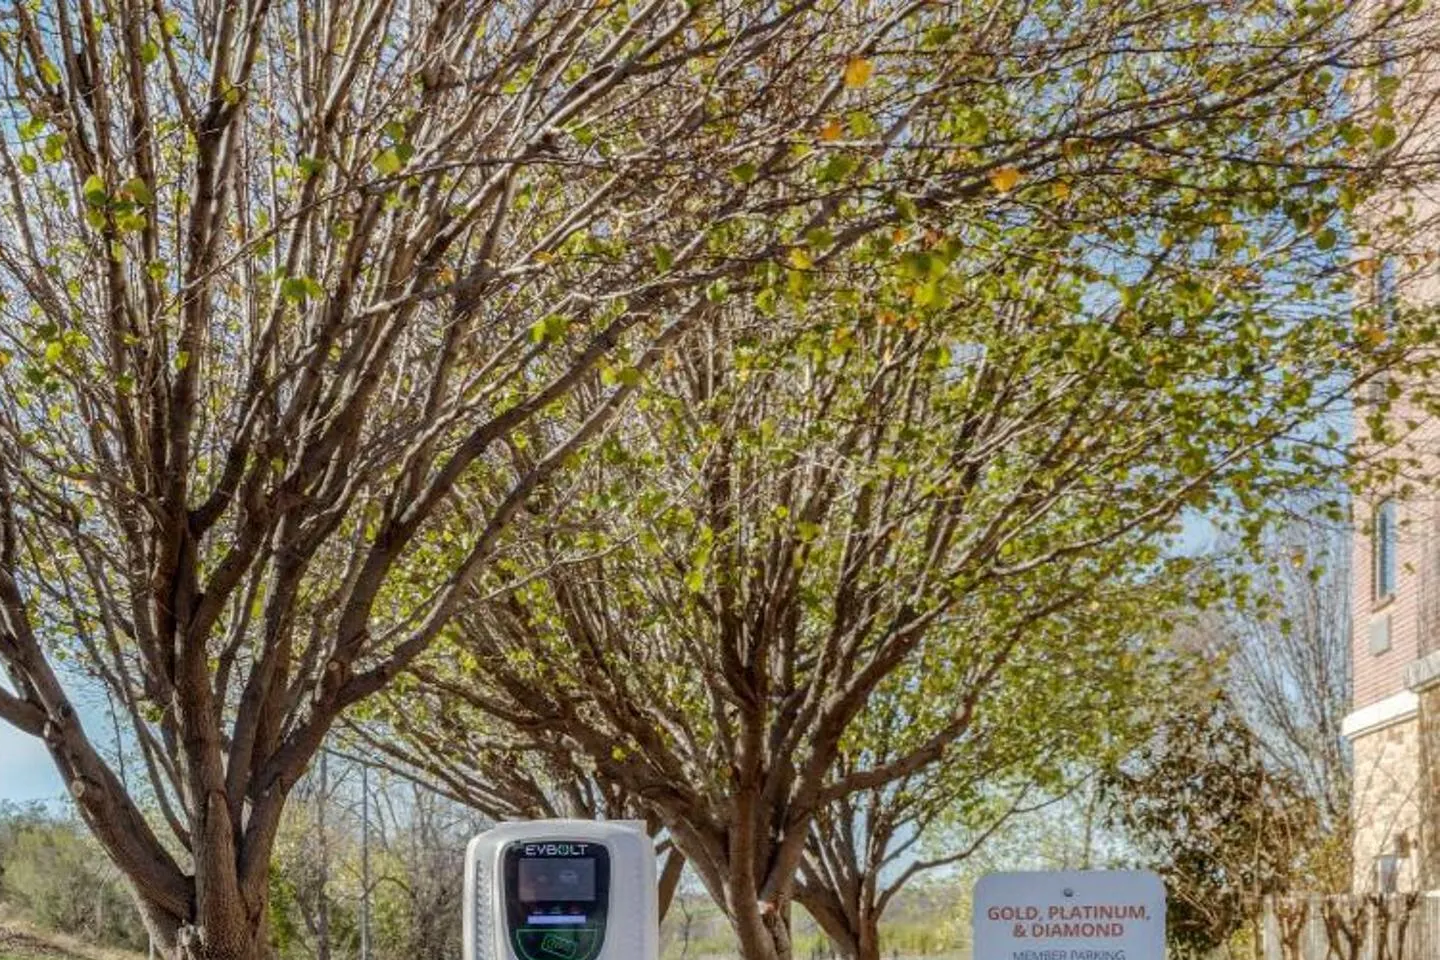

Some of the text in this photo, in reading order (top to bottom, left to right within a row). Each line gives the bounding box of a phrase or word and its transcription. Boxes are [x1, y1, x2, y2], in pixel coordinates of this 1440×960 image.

[525, 844, 589, 856] EVBOLT
[987, 905, 1152, 922] GOLD, PLATINUM,
[1012, 922, 1124, 938] & DIAMOND
